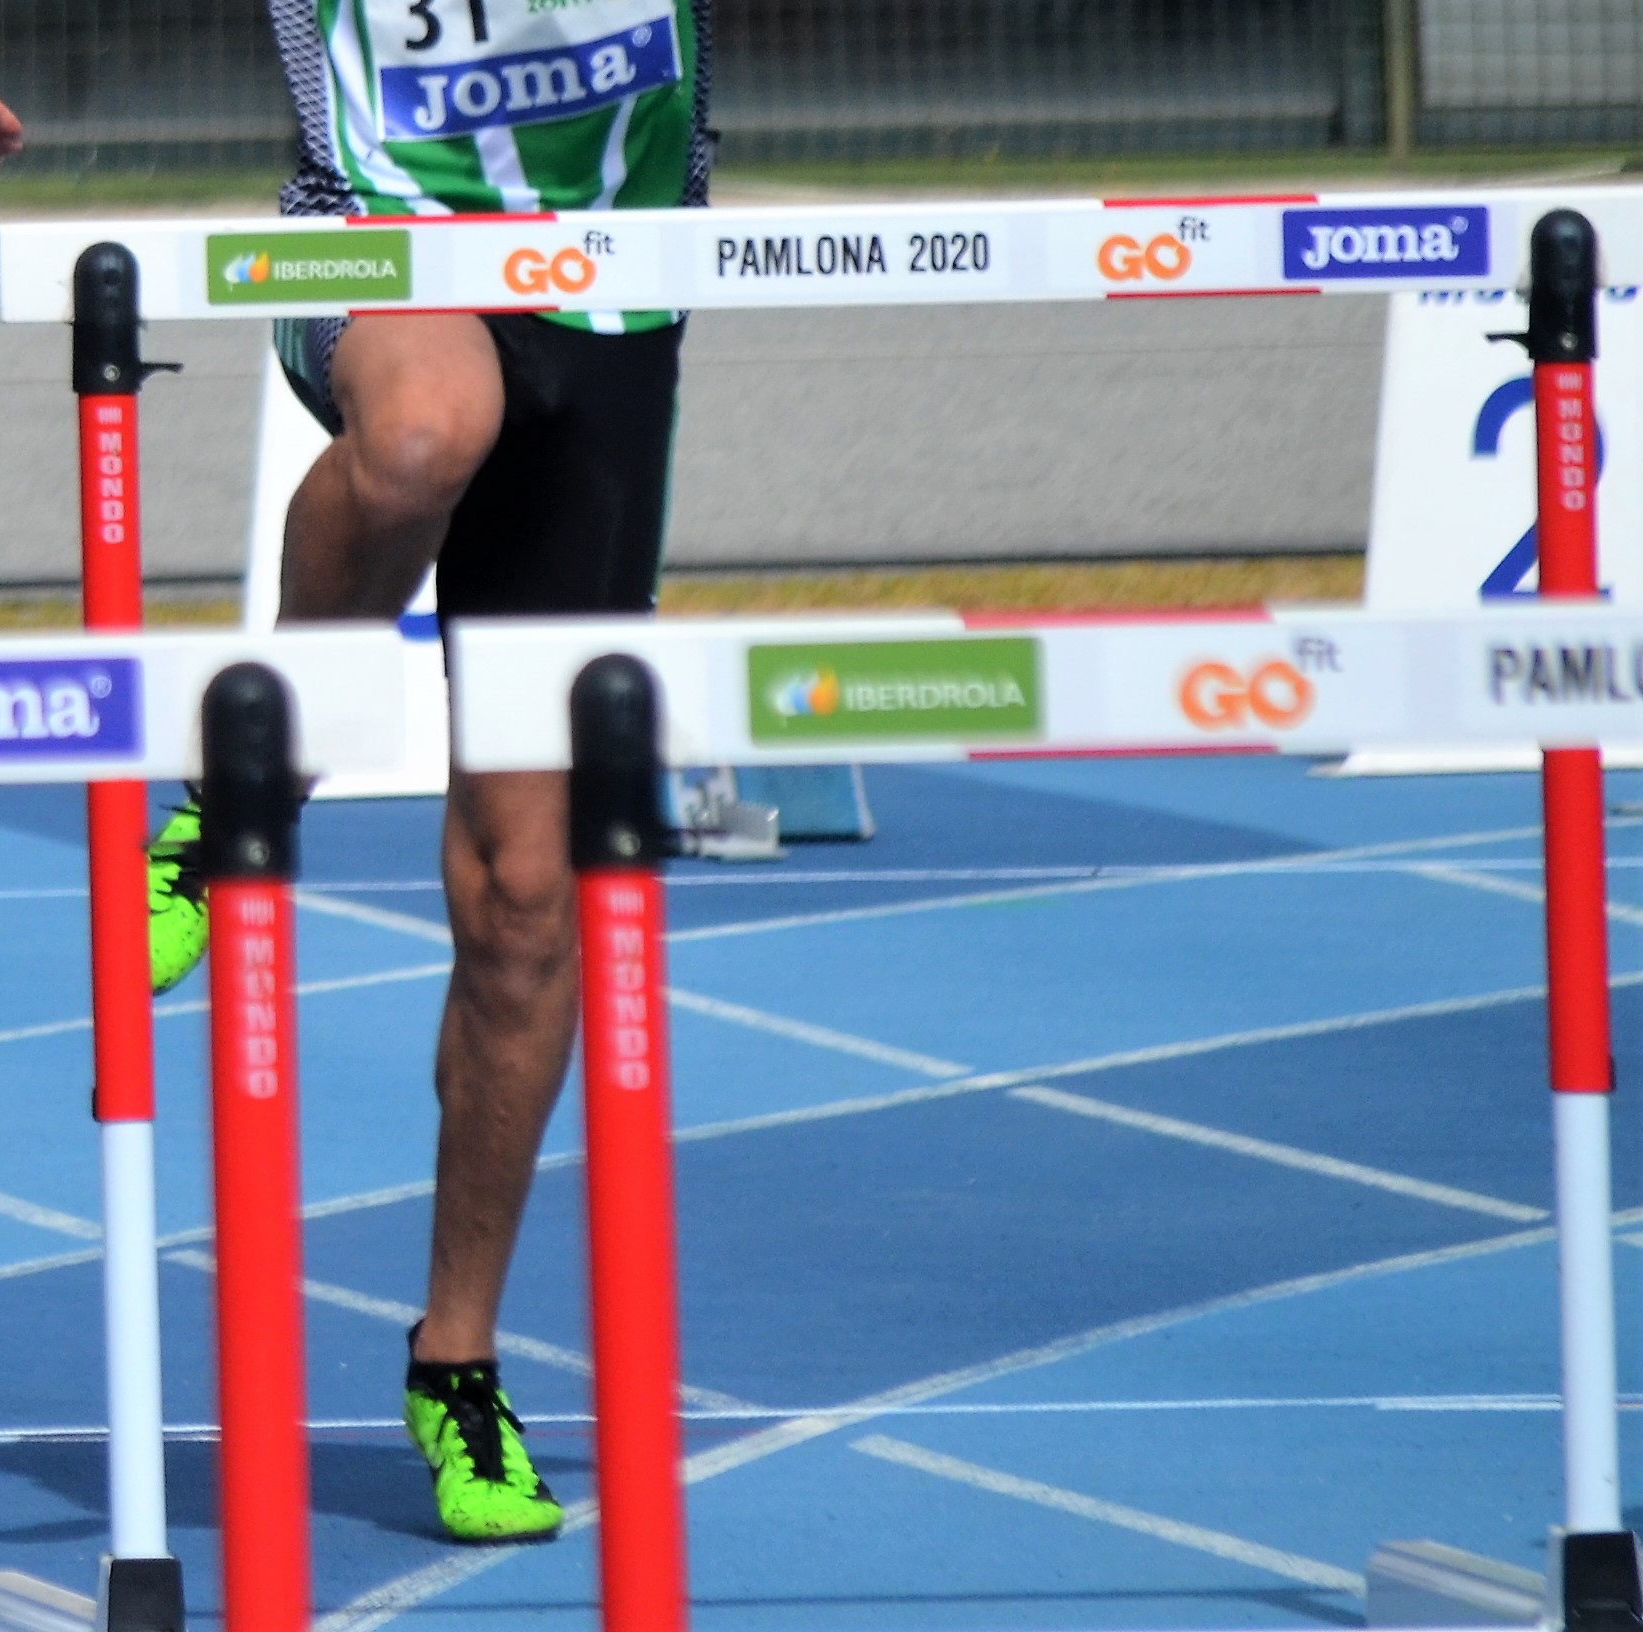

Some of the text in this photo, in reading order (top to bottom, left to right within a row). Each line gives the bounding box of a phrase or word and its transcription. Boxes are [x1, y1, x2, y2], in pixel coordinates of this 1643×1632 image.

[273, 259, 397, 282] IBERDROLA
[503, 230, 616, 295] GO fit
[717, 233, 990, 277] PAMLONA 2020
[1097, 216, 1210, 281] GO fit
[99, 432, 125, 545] MONDO
[1557, 398, 1586, 512] MONDO
[846, 678, 1027, 712] IBERDROLA
[1178, 635, 1342, 731] GO fit
[242, 937, 277, 1099] MONDO
[612, 928, 650, 1090] MONDO
